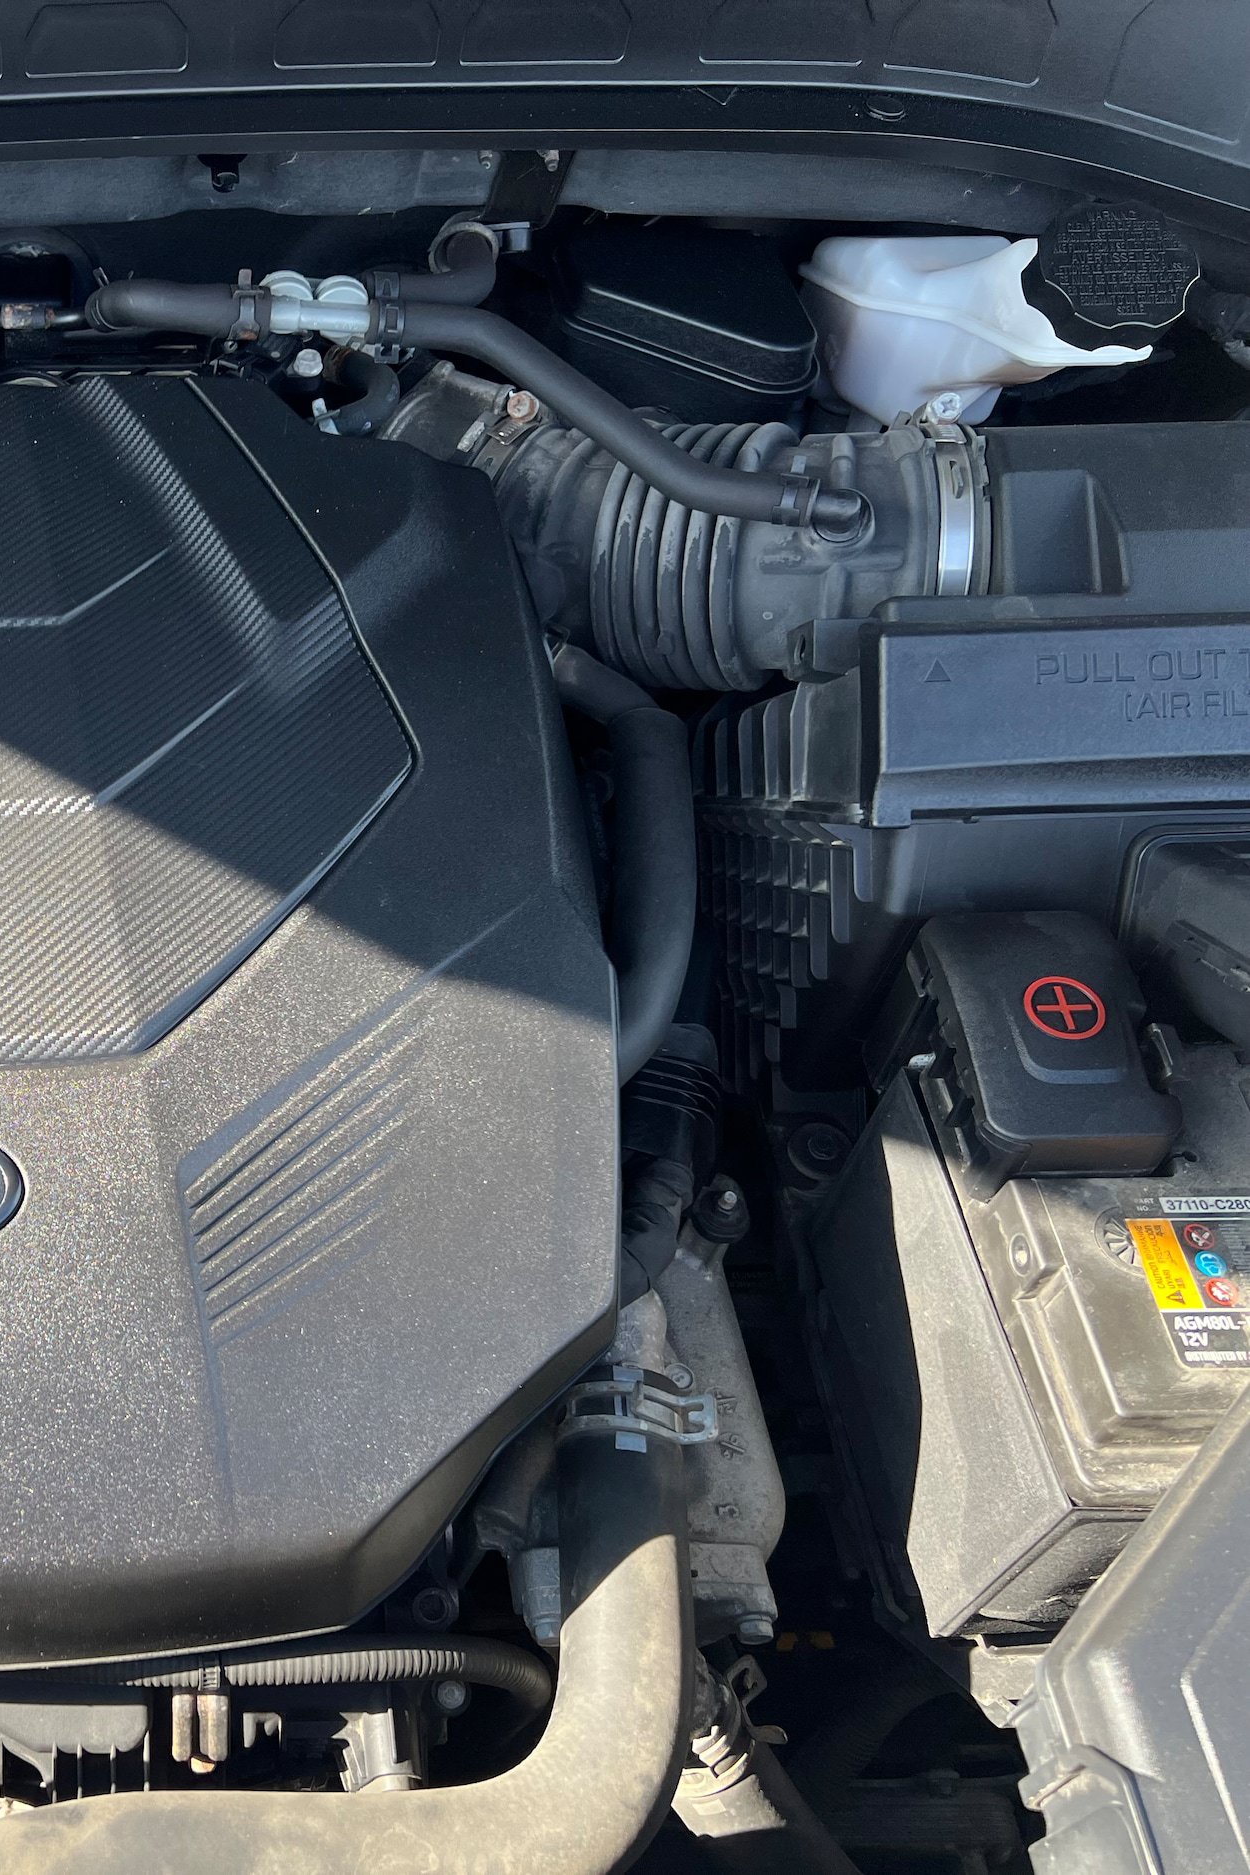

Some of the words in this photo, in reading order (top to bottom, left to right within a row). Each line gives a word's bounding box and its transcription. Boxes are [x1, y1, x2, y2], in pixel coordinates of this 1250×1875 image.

[1036, 652, 1135, 684] PULL
[1147, 649, 1226, 681] OUT
[1203, 689, 1250, 717] FIL
[1178, 1332, 1209, 1347] 12V
